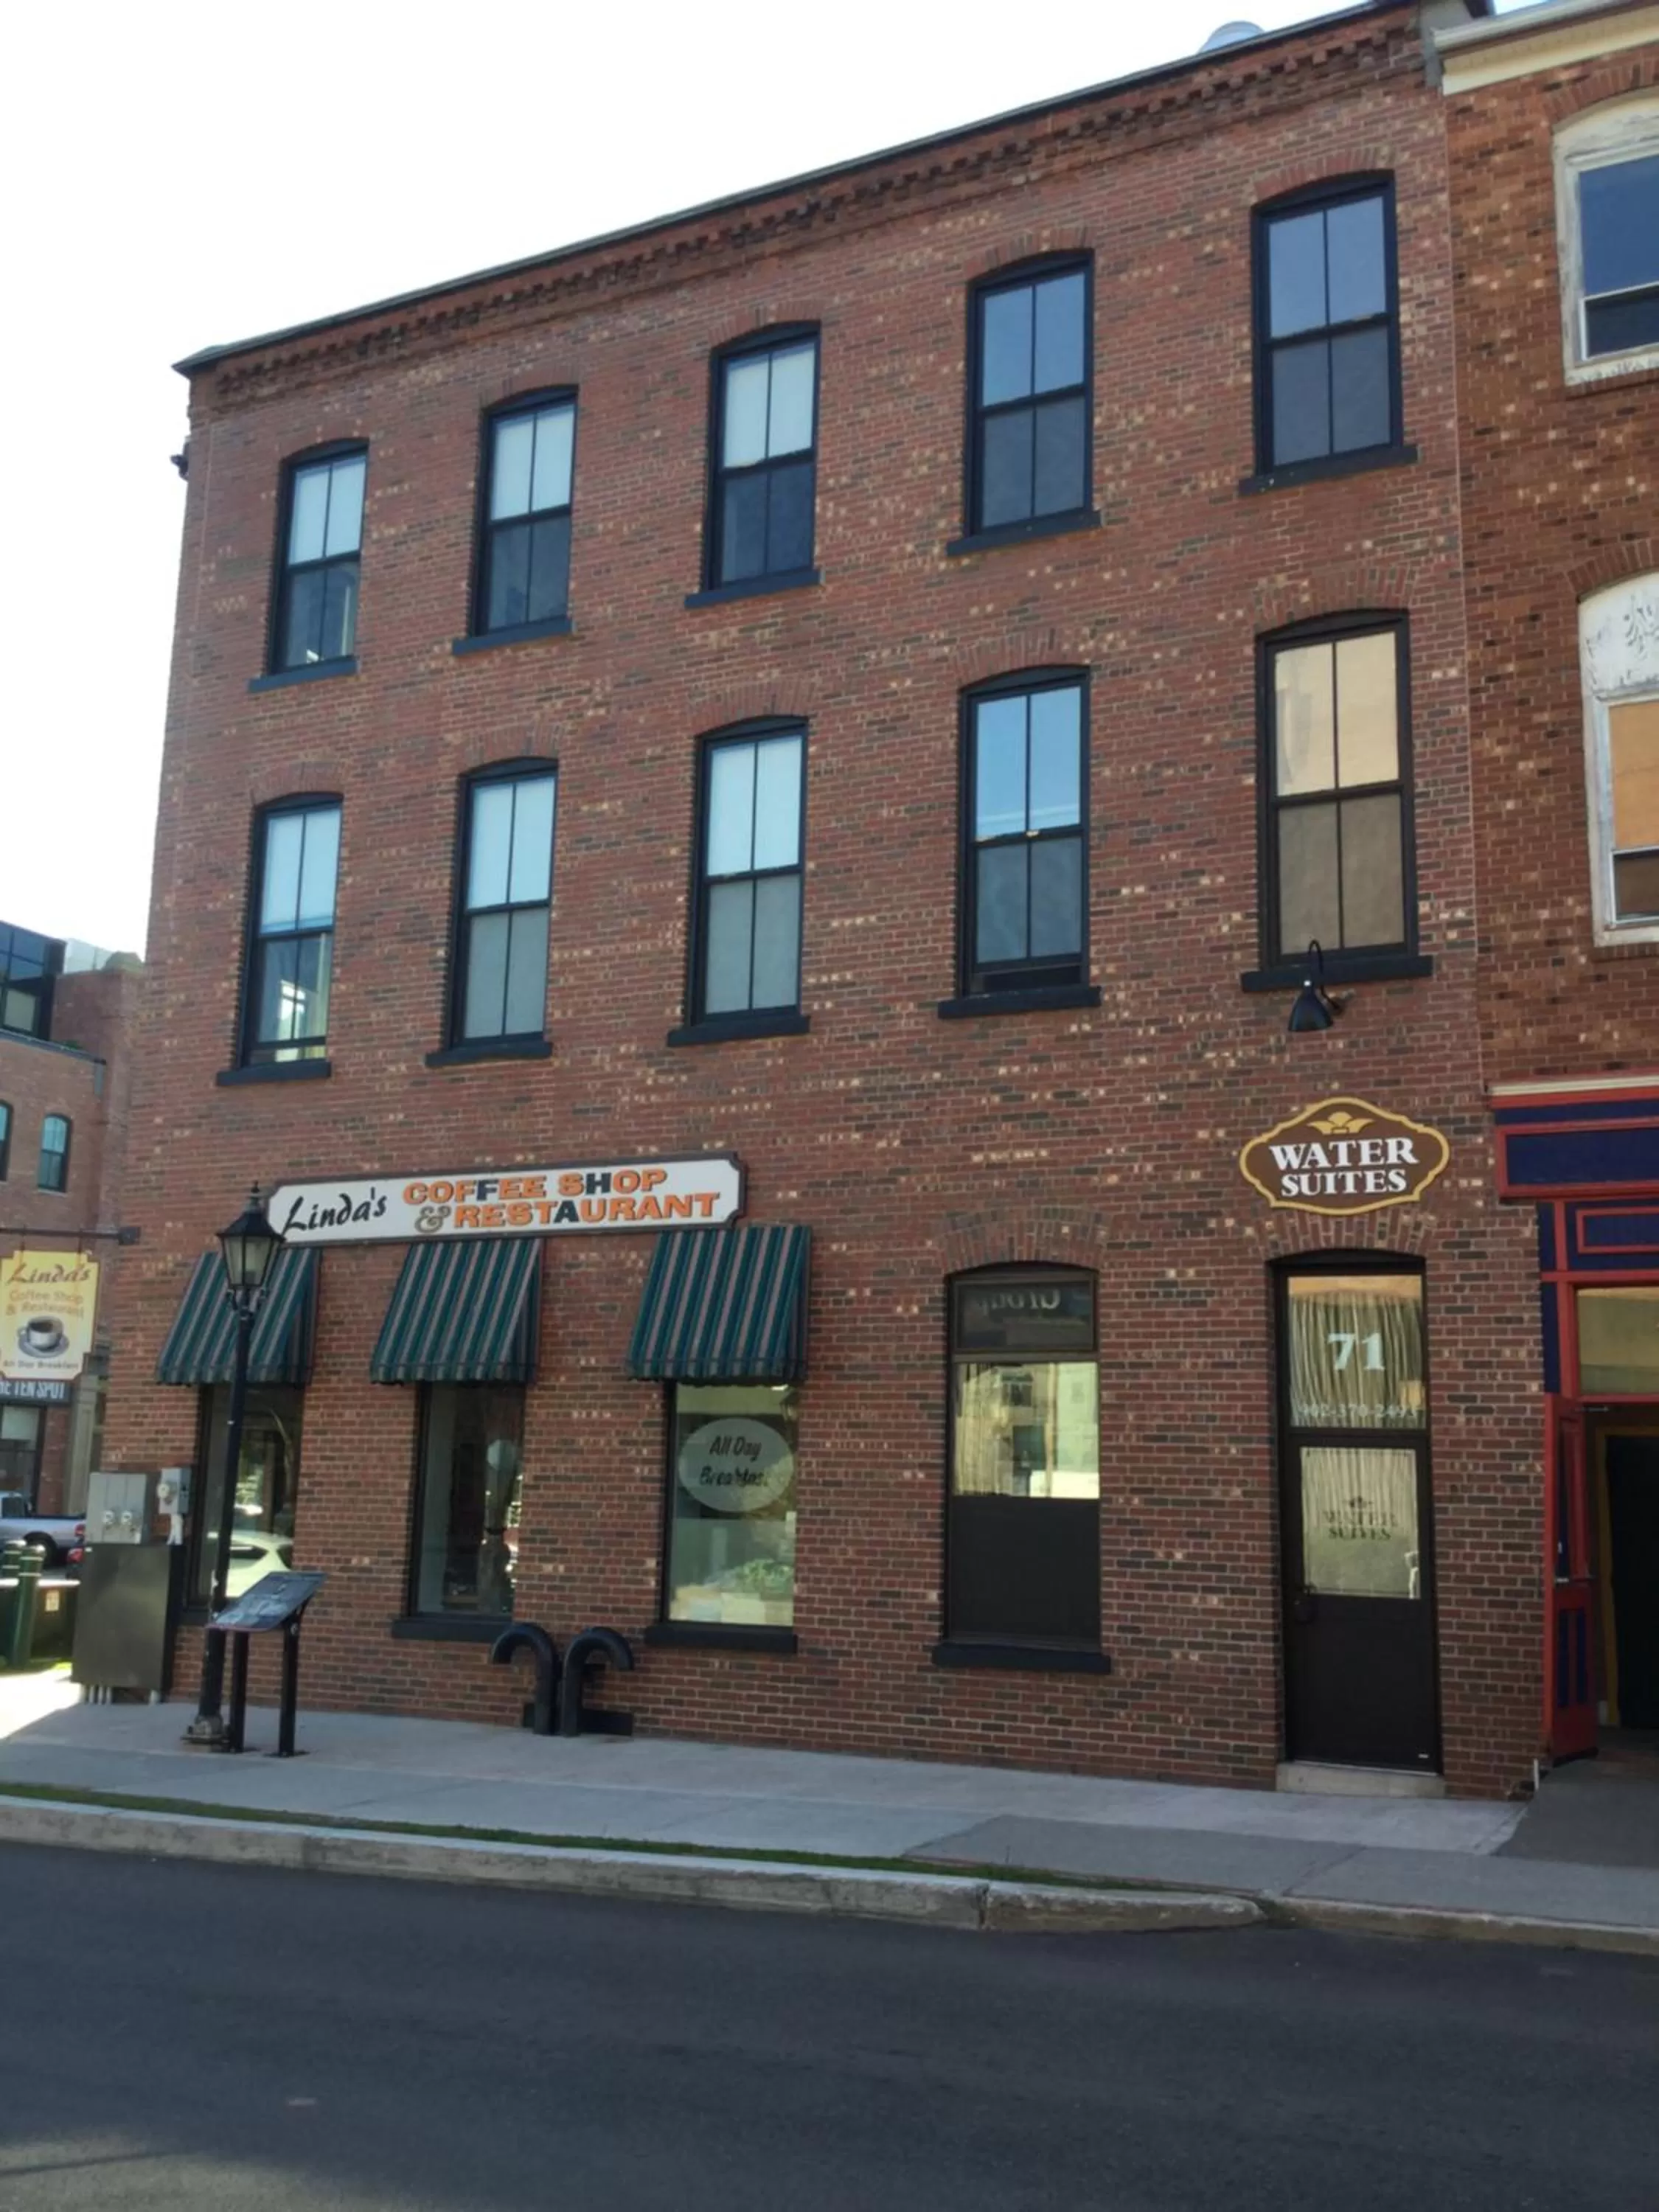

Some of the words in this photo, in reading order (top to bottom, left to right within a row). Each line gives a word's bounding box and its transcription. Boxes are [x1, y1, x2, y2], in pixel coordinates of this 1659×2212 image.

[1269, 1137, 1420, 1171] WATER
[403, 1175, 547, 1205] COFFEE
[557, 1168, 668, 1197] SHOP
[1281, 1169, 1407, 1197] SUITES
[282, 1186, 387, 1237] Linda's
[414, 1205, 452, 1234] &
[453, 1191, 720, 1228] RESTAURANT
[5, 1262, 91, 1286] Linda's
[1327, 1332, 1385, 1371] 71
[35, 1381, 66, 1399] SPOT
[709, 1436, 732, 1455] All
[732, 1436, 762, 1463] Day
